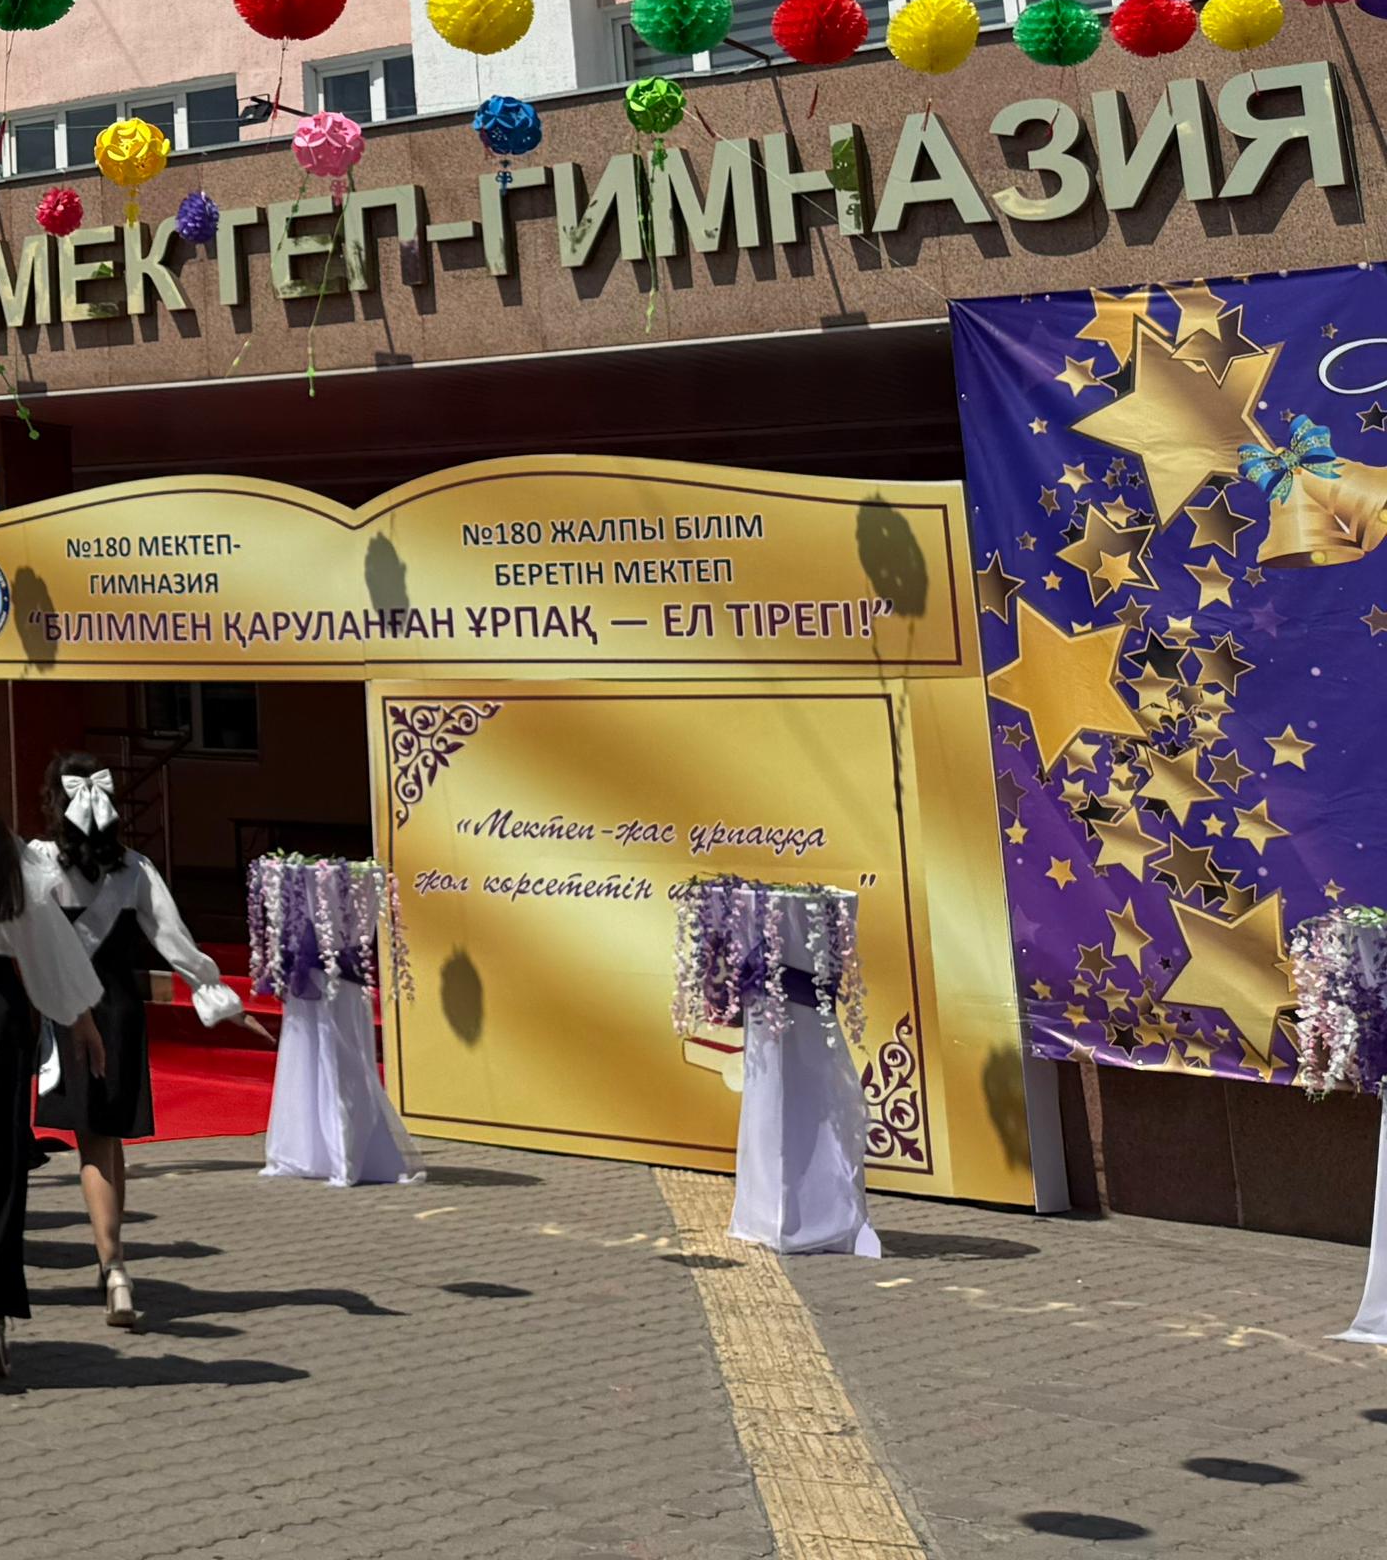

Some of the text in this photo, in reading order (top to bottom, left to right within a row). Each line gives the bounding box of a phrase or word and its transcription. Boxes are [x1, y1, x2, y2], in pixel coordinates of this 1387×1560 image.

[463, 515, 763, 545] №180 ЖАЛПЫ БІЛІМ
[66, 534, 241, 557] №180 МЕКТЕП-
[89, 573, 219, 594] ГИМНАЗИЯ
[495, 559, 732, 586] БЕРЕТІН МЕКТЕП
[28, 611, 212, 641] “БІЛІММЕН
[223, 607, 454, 648] ҚАРУЛАНҒАН
[465, 605, 598, 645] ҰРПАҚ
[663, 604, 713, 637] ЕЛ
[414, 869, 469, 895] жол
